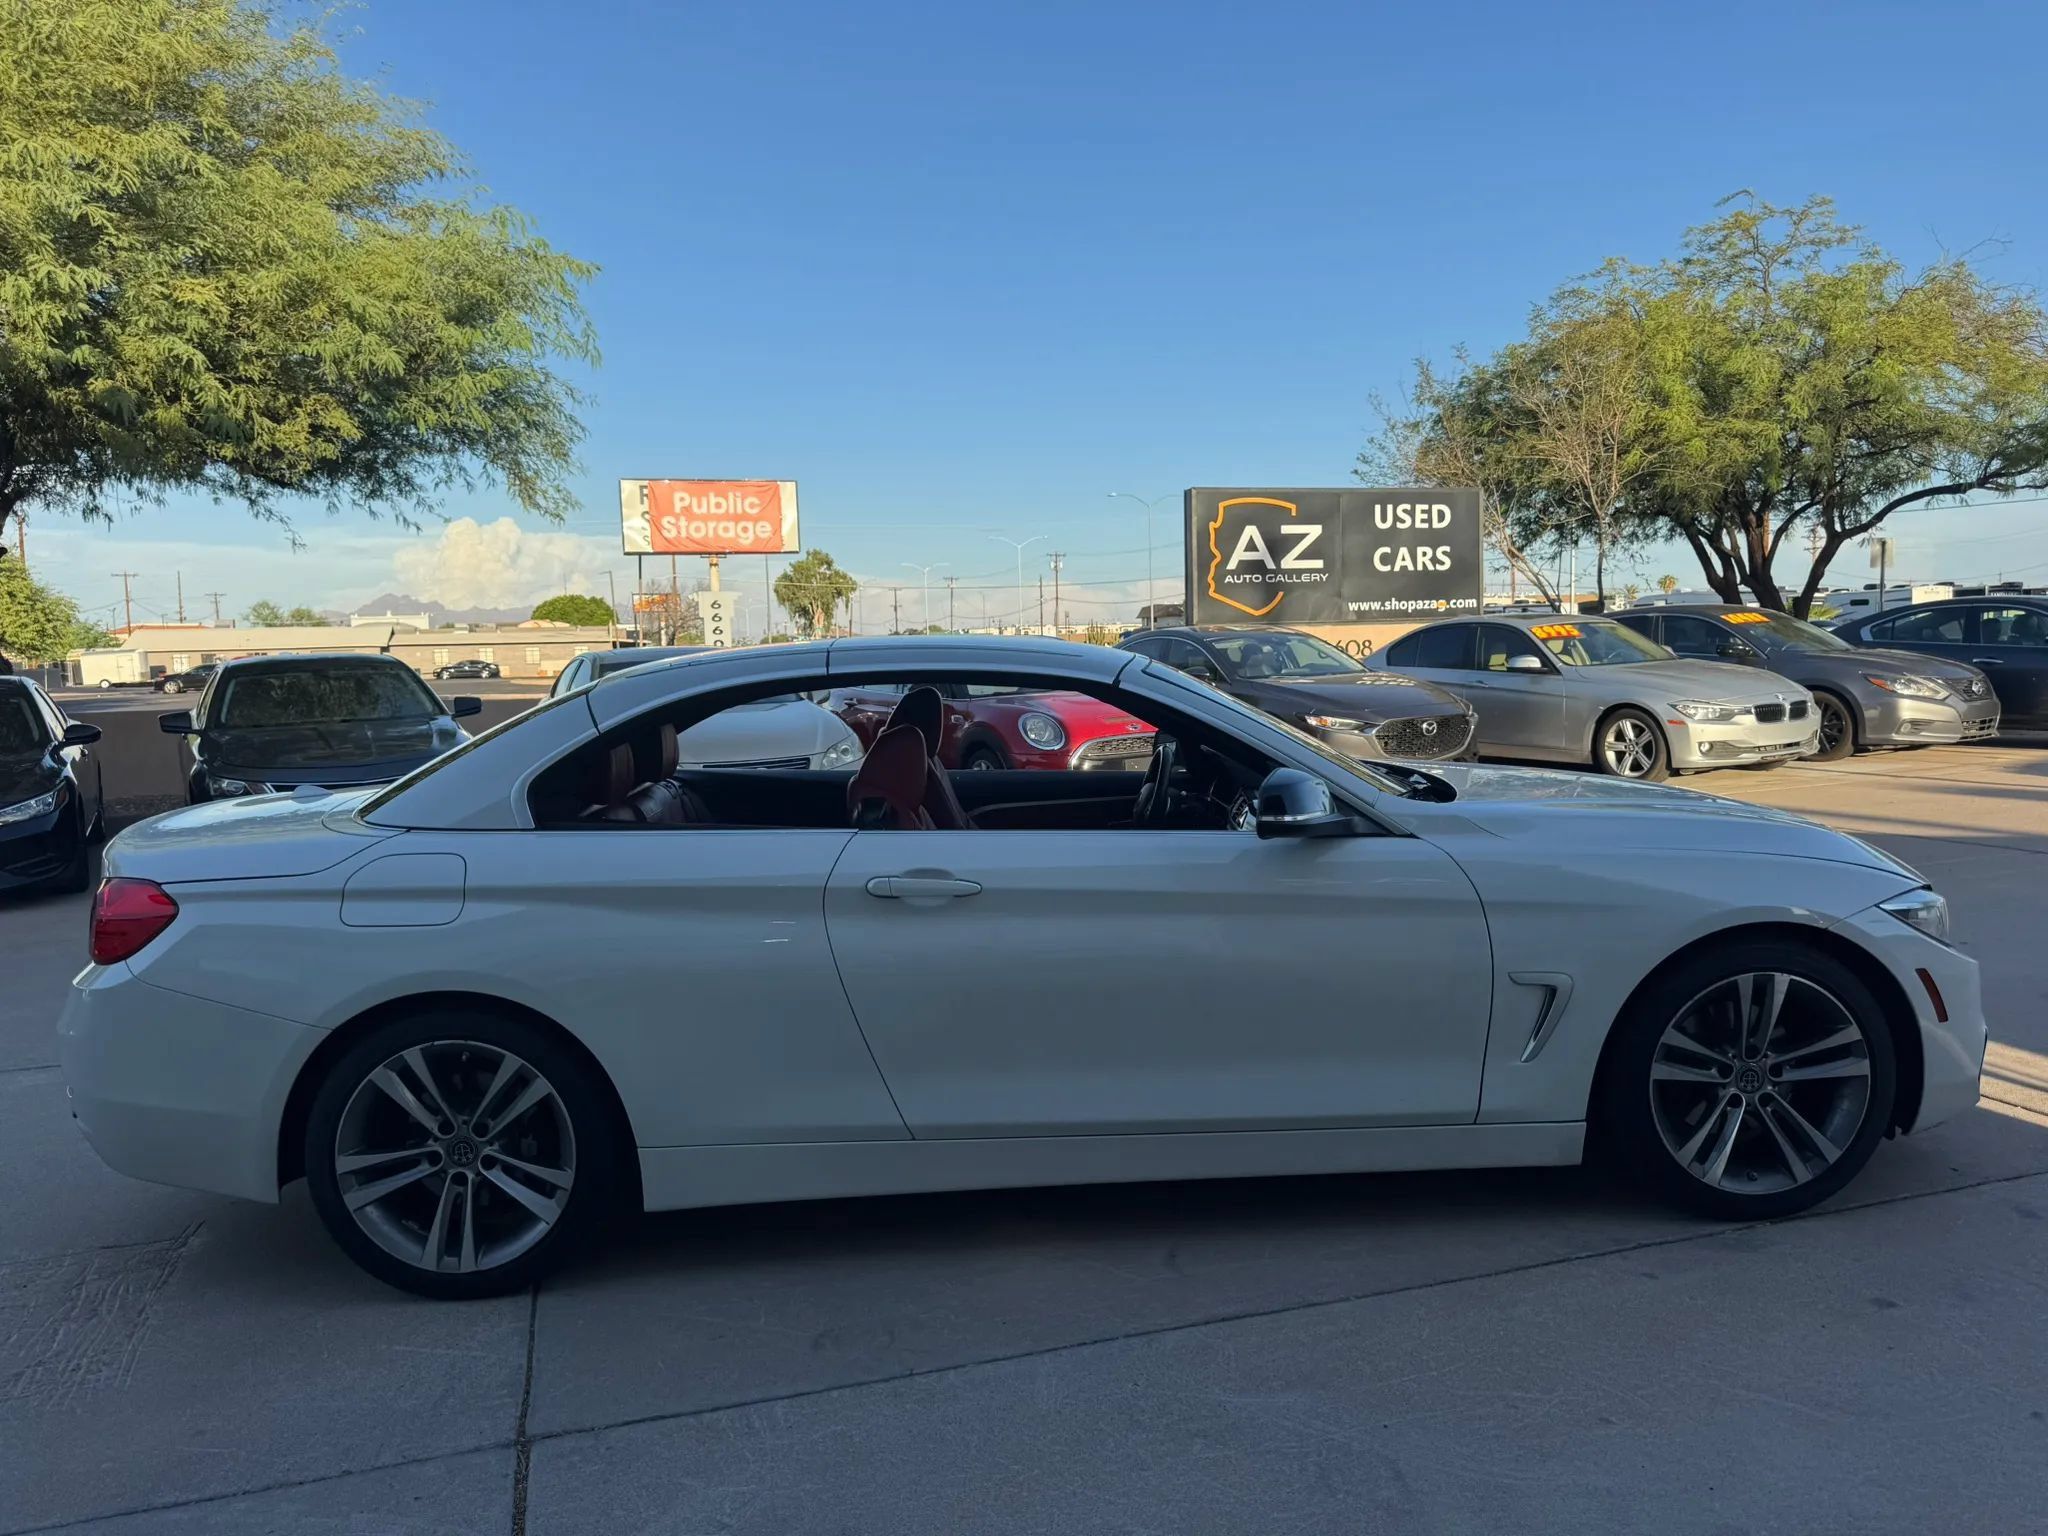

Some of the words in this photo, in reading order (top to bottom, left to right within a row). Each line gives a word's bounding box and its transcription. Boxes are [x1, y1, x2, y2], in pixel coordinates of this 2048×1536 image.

[673, 491, 761, 515] Public
[661, 515, 772, 544] Storage
[1374, 503, 1451, 530] USED
[1226, 524, 1324, 570] AZ
[1373, 546, 1451, 572] CARS
[1224, 573, 1262, 584] AUTO
[1265, 572, 1329, 583] GALLERY
[1348, 597, 1477, 612] www.shopazag.com
